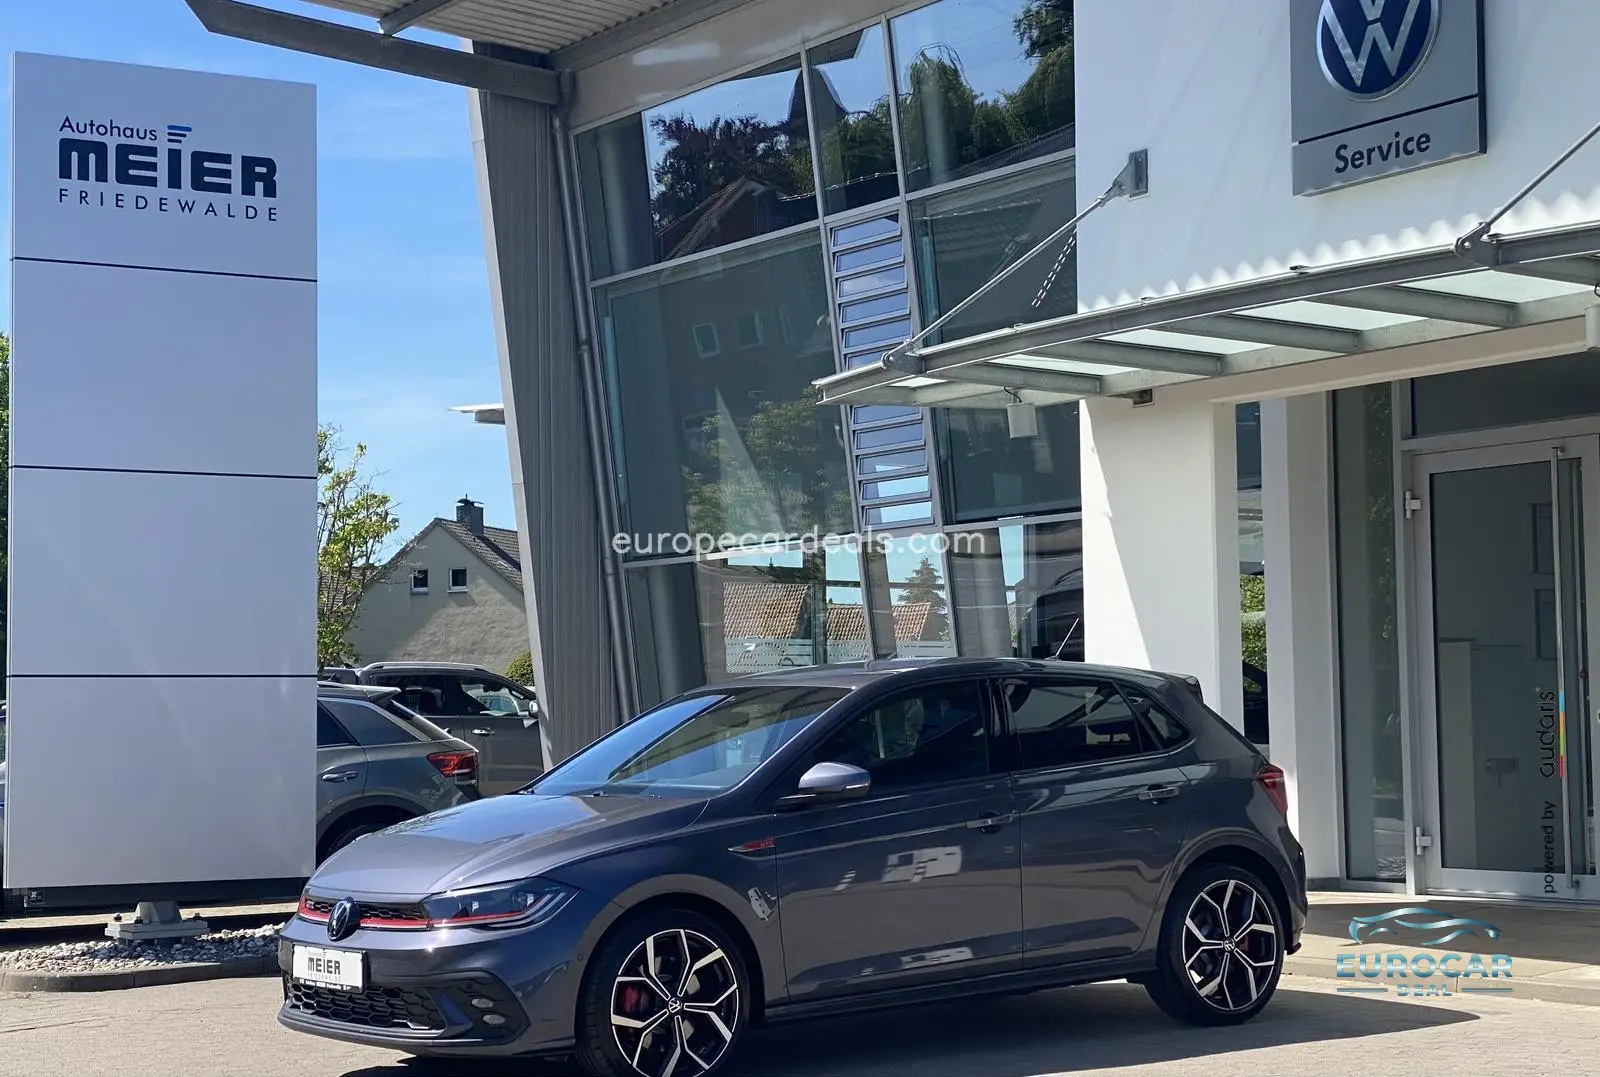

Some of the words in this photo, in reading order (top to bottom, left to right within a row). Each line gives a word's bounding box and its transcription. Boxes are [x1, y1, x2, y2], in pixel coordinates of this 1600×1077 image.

[59, 115, 158, 141] Autohaus
[58, 136, 277, 199] MEIER
[1334, 131, 1431, 174] Service
[59, 188, 278, 222] FRIEDEWALDE
[308, 957, 341, 975] MEIER
